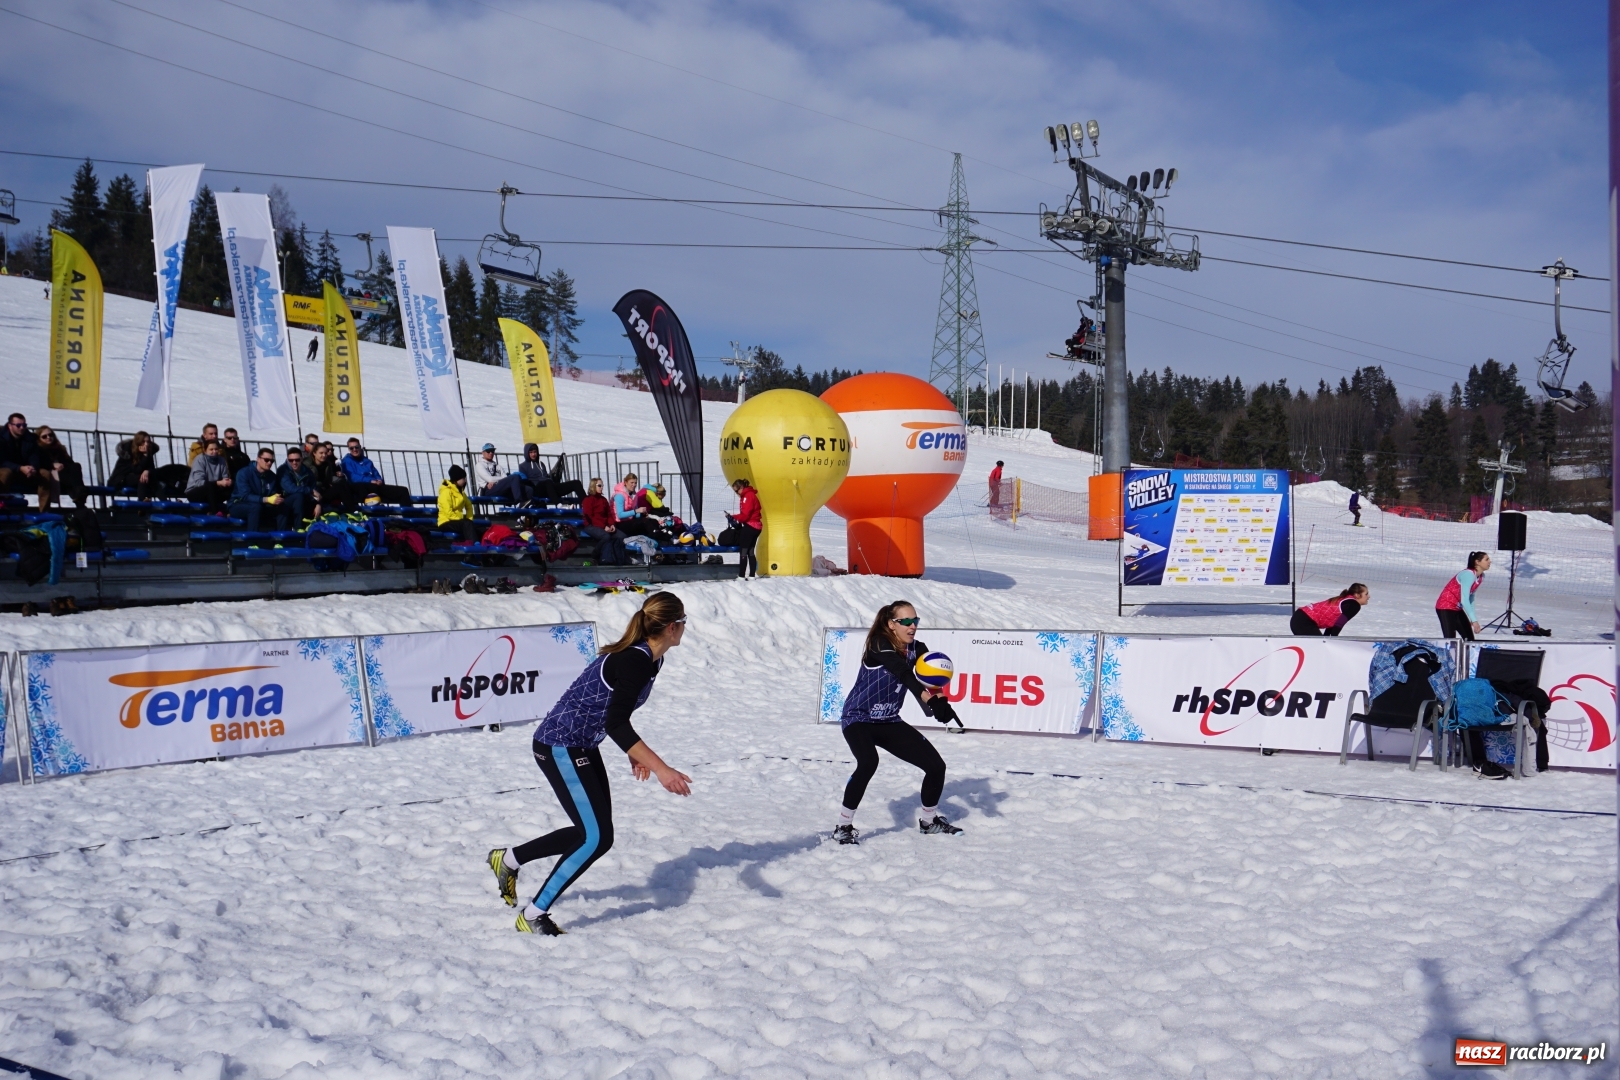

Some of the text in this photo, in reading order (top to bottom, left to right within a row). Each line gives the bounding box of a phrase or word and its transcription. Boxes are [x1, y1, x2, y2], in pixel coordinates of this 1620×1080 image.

[293, 301, 311, 309] RMF
[901, 421, 966, 450] Terma
[791, 456, 834, 468] zakłady
[1128, 472, 1168, 496] SNOW
[1183, 473, 1256, 483] MISTRZOSTWA POLSKI
[1128, 484, 1174, 509] VOLLEY
[108, 665, 284, 729] Terma
[930, 673, 1045, 706] ULES
